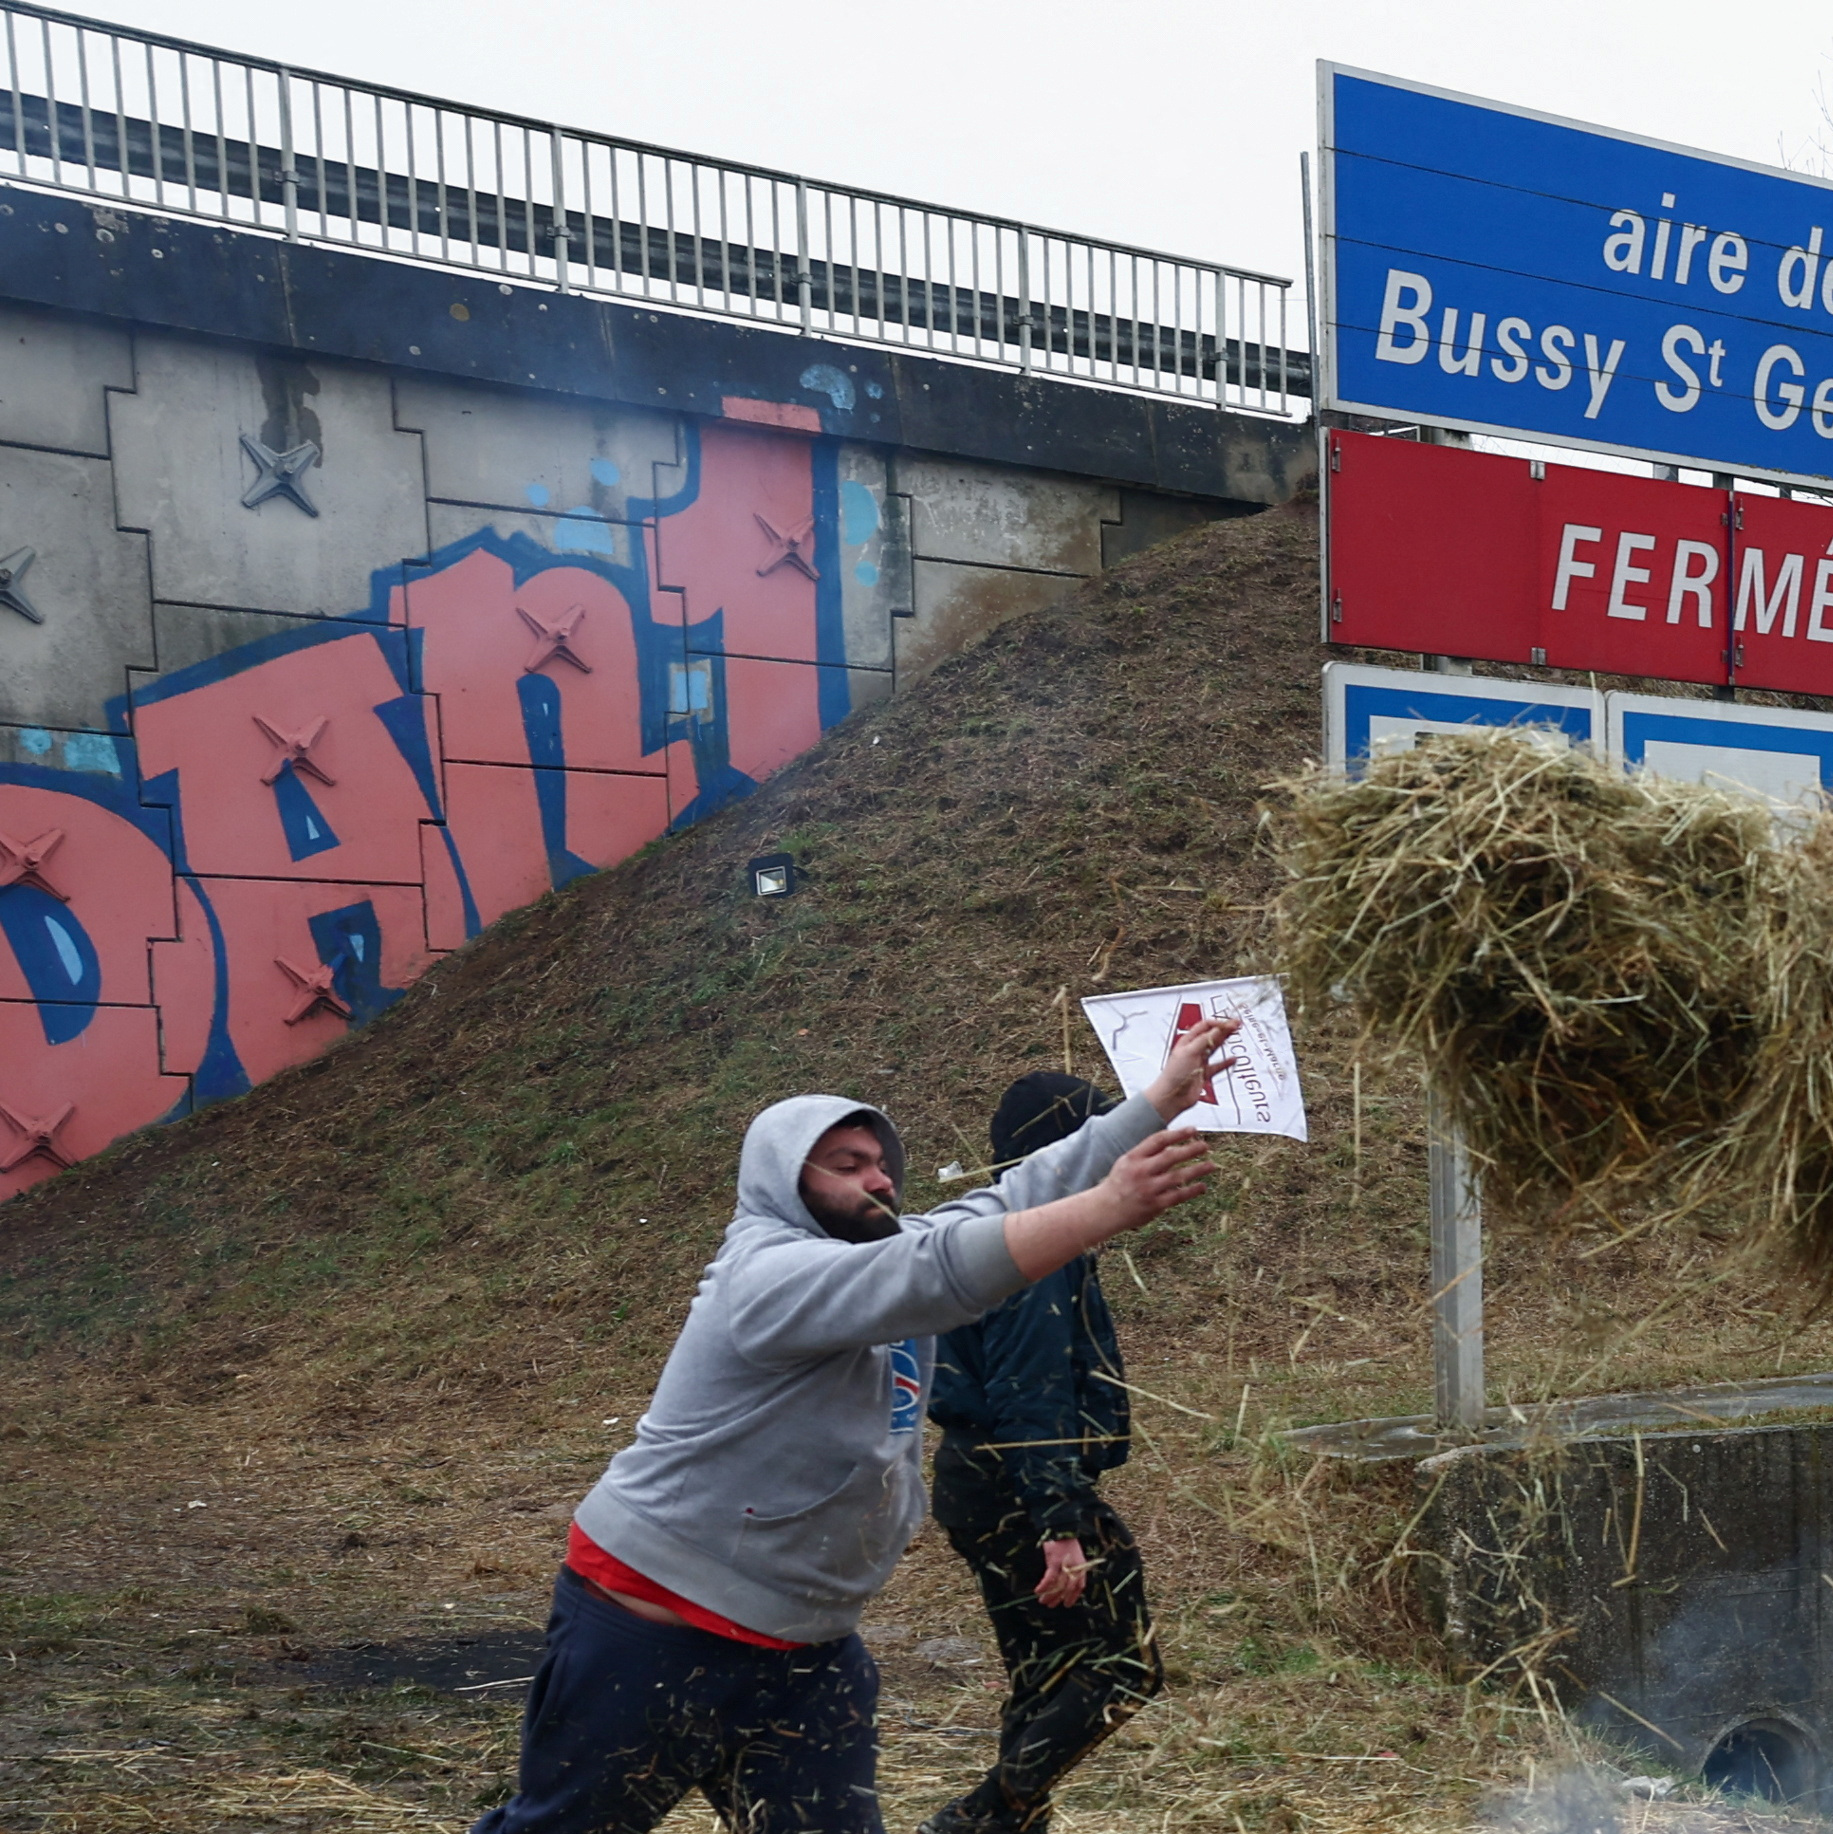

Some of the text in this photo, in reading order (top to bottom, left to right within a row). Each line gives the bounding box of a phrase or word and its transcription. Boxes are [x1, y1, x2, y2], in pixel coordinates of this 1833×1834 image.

[1603, 192, 1749, 295] aire
[1374, 267, 1626, 419] Bussy
[1654, 324, 1727, 413] St
